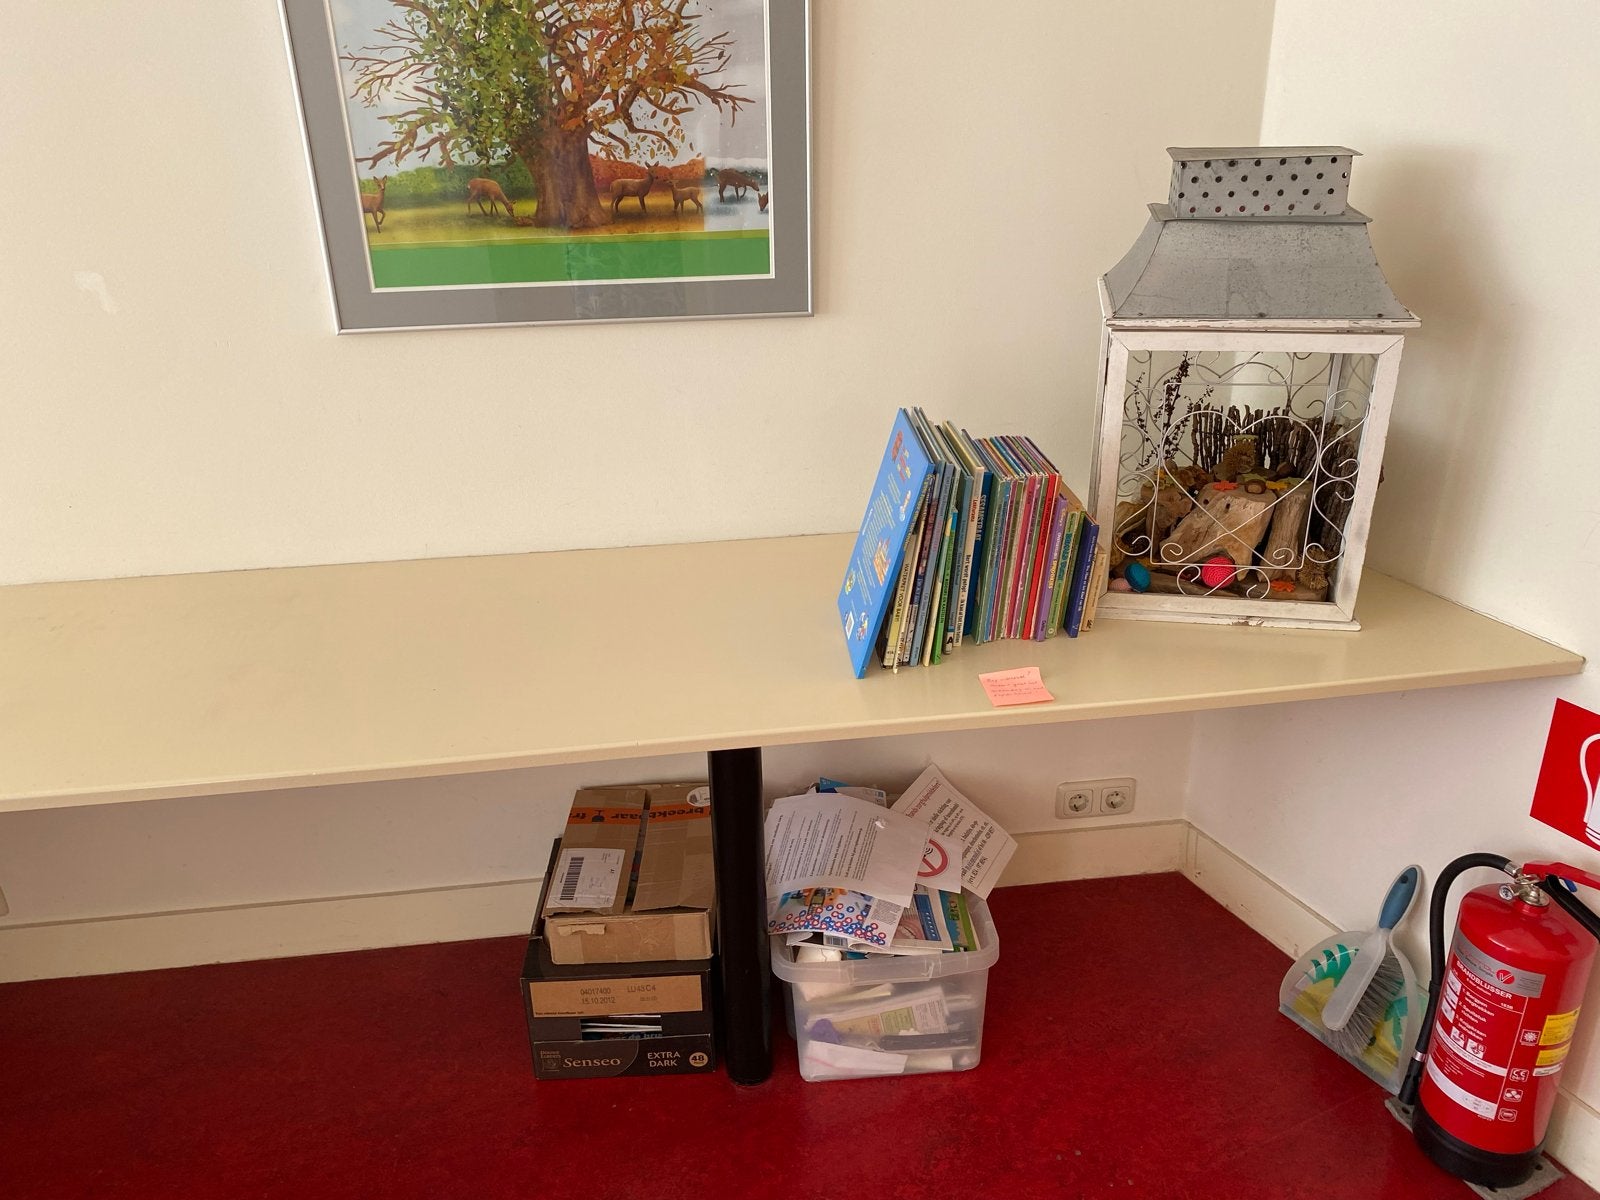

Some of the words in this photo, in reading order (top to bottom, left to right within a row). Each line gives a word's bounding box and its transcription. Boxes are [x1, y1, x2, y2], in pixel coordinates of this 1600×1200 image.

[974, 494, 986, 542] SESAMSTRAAT
[1456, 960, 1512, 999] BRANDBLUSSER
[563, 1058, 620, 1067] Senseo
[648, 1052, 680, 1060] EXTRA
